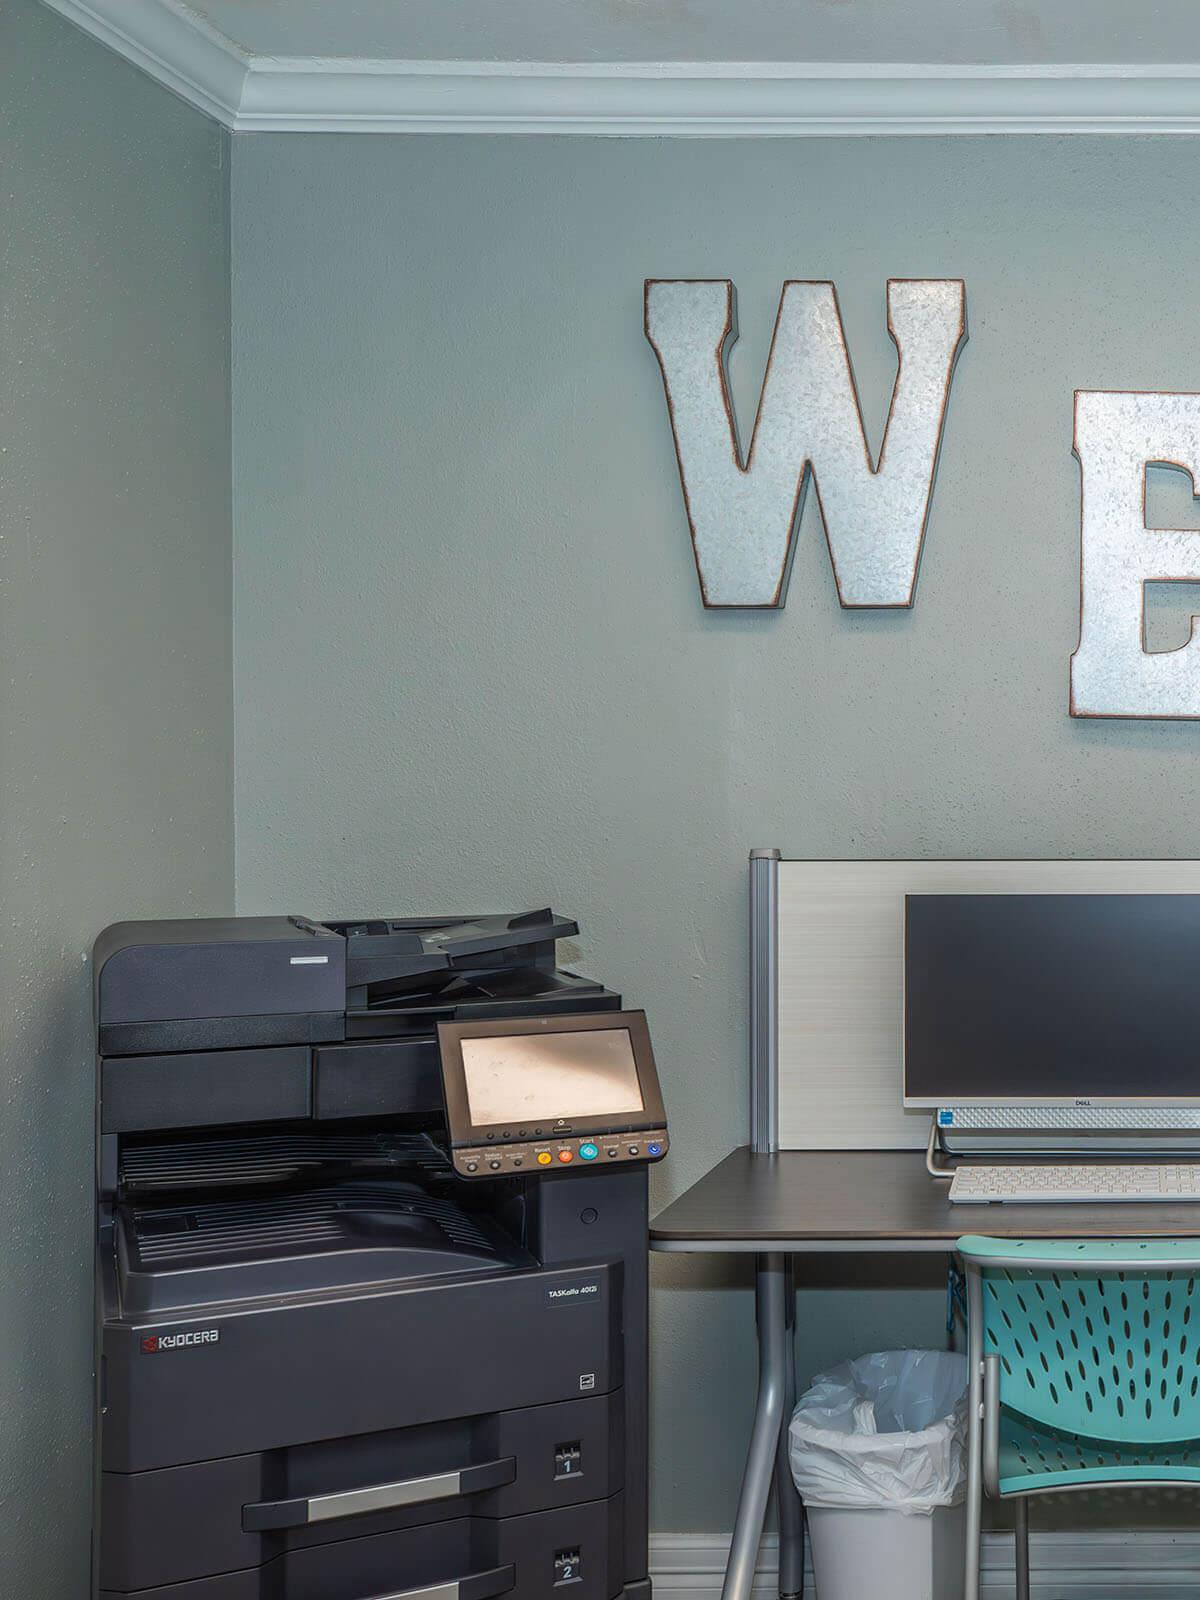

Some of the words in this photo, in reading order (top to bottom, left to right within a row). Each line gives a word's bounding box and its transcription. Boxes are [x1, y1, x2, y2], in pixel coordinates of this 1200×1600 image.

[158, 1329, 219, 1349] KYOCERA
[563, 1460, 571, 1473] 1
[563, 1566, 572, 1579] 2
